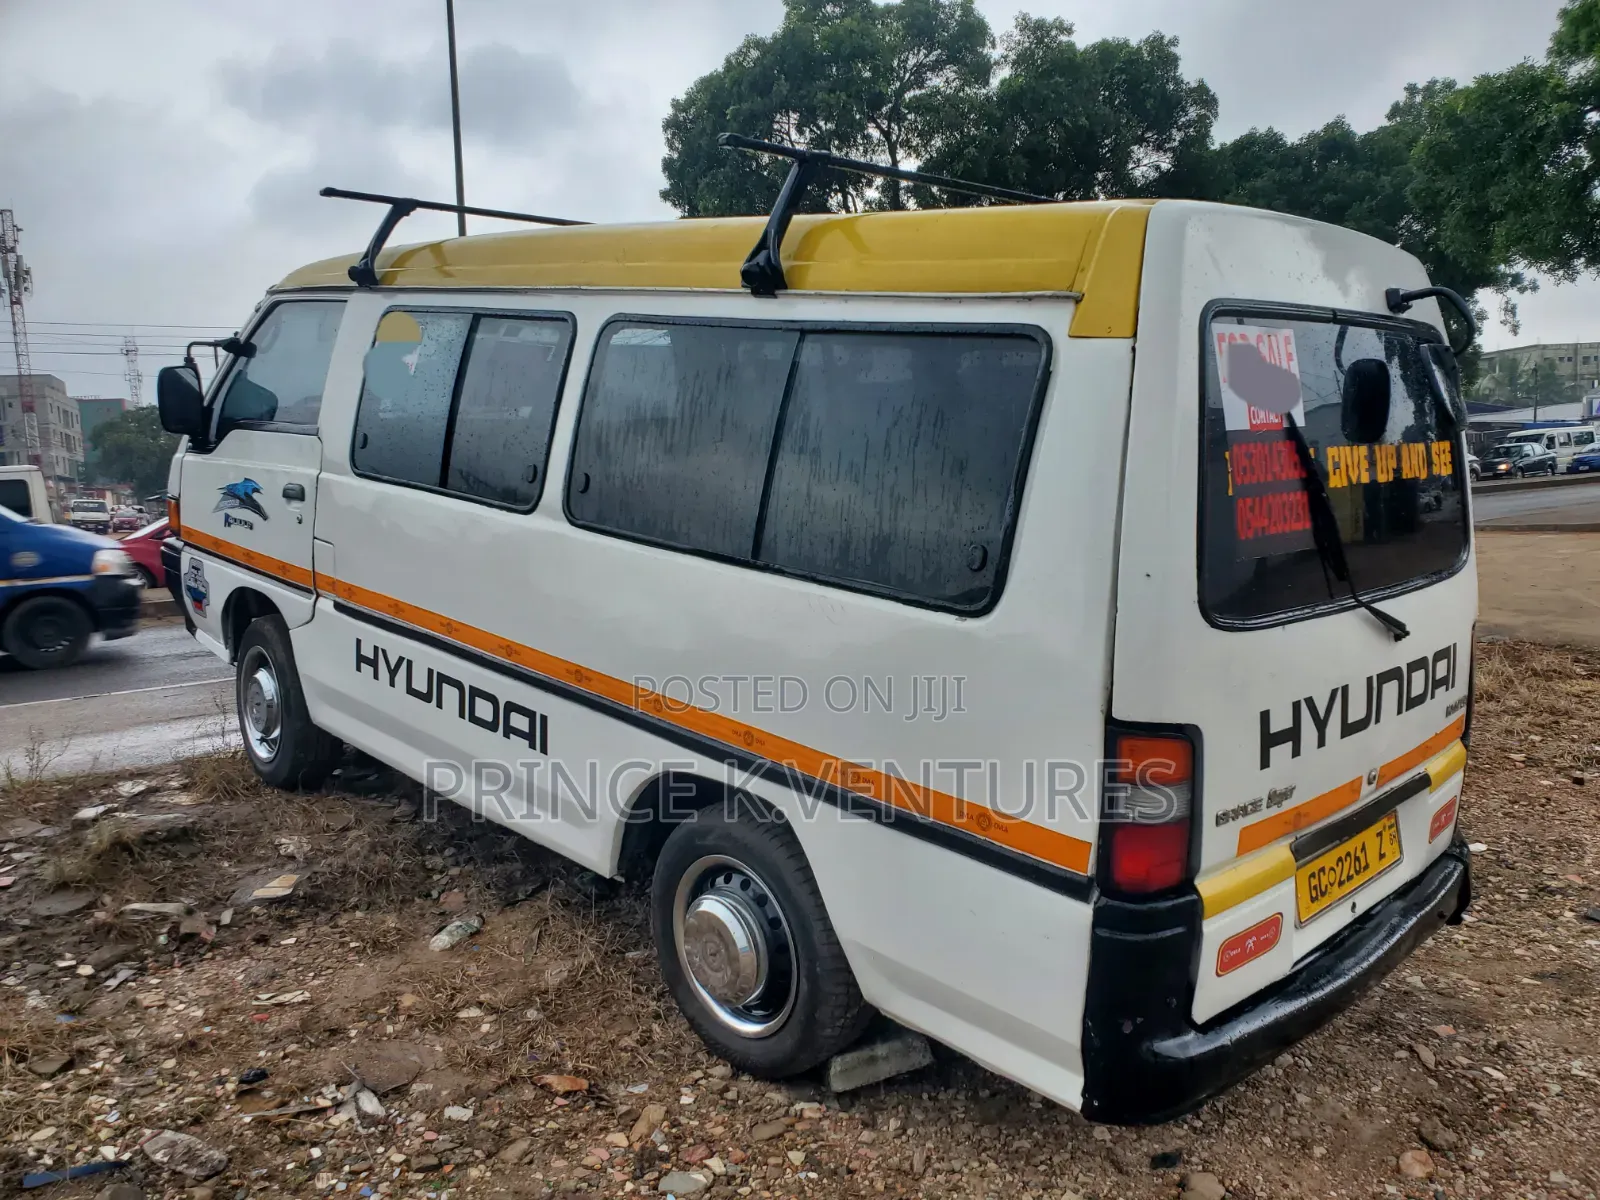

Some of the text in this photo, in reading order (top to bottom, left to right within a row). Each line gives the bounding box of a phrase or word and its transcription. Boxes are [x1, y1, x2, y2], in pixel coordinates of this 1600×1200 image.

[1327, 440, 1452, 487] GIVE UP AND SEE
[355, 637, 549, 756] HYUNDAI
[1259, 642, 1458, 771] HYUNDAI
[1308, 829, 1387, 904] GC 2261 Z
